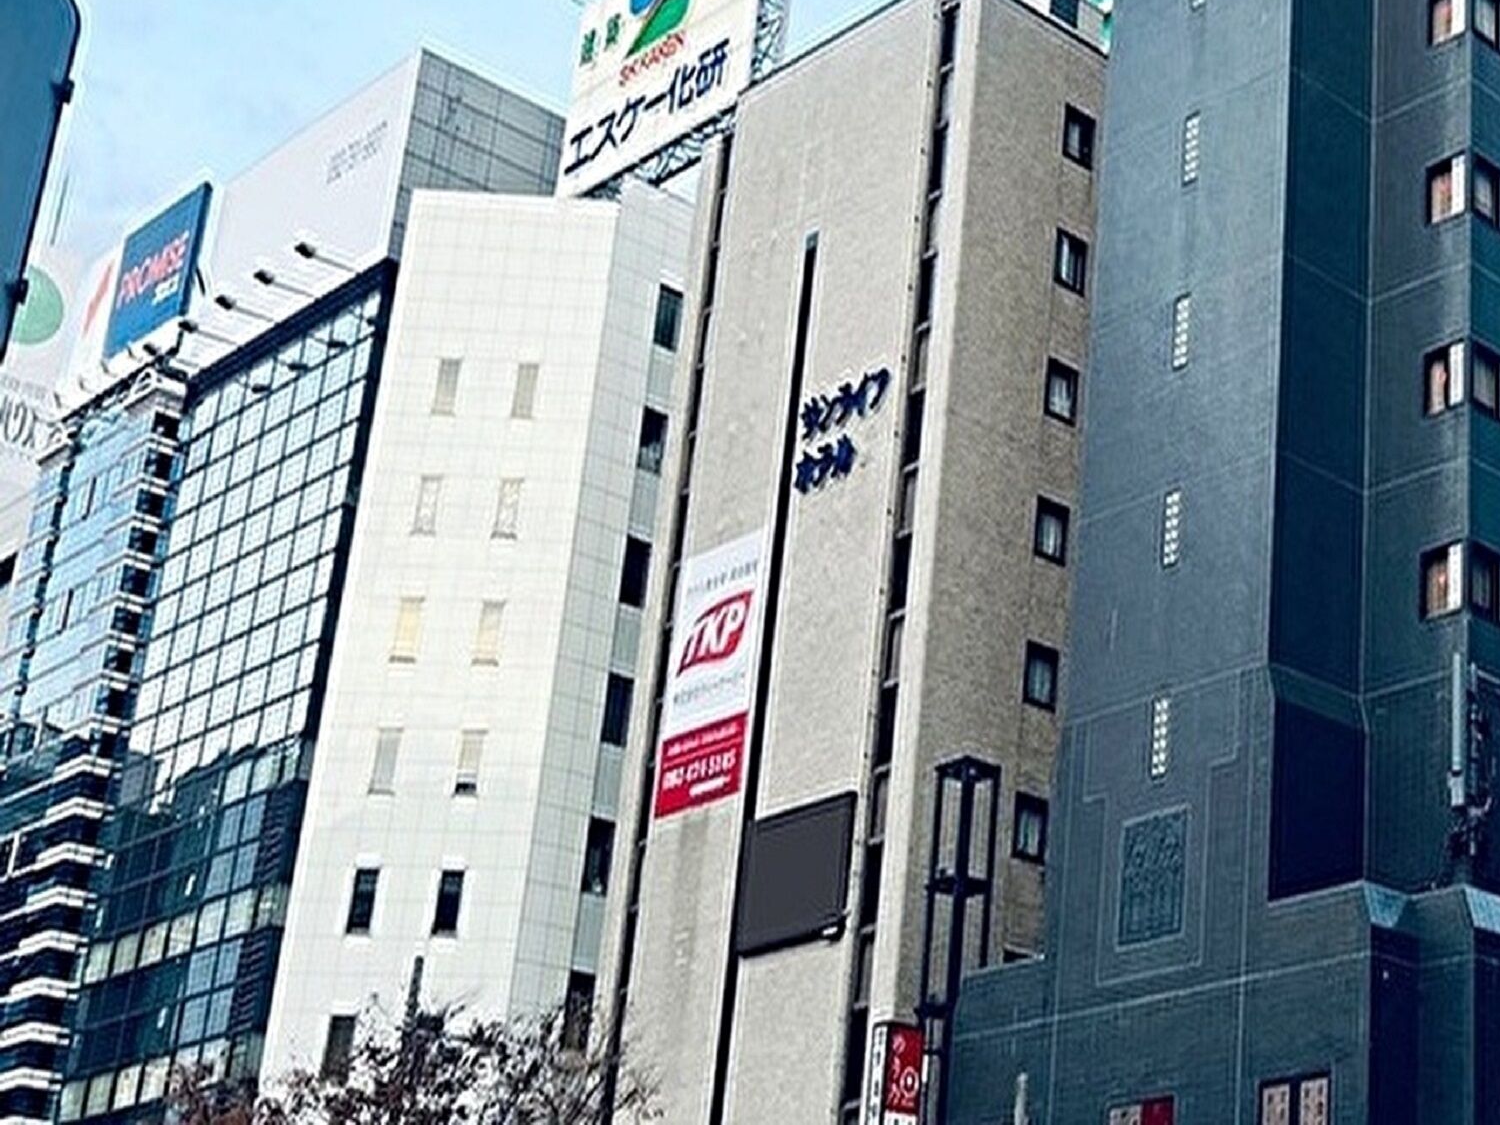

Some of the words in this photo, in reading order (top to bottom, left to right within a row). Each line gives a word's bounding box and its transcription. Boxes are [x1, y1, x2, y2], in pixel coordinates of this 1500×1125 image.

[564, 37, 731, 176] エスケー化研
[684, 597, 748, 665] TKP
